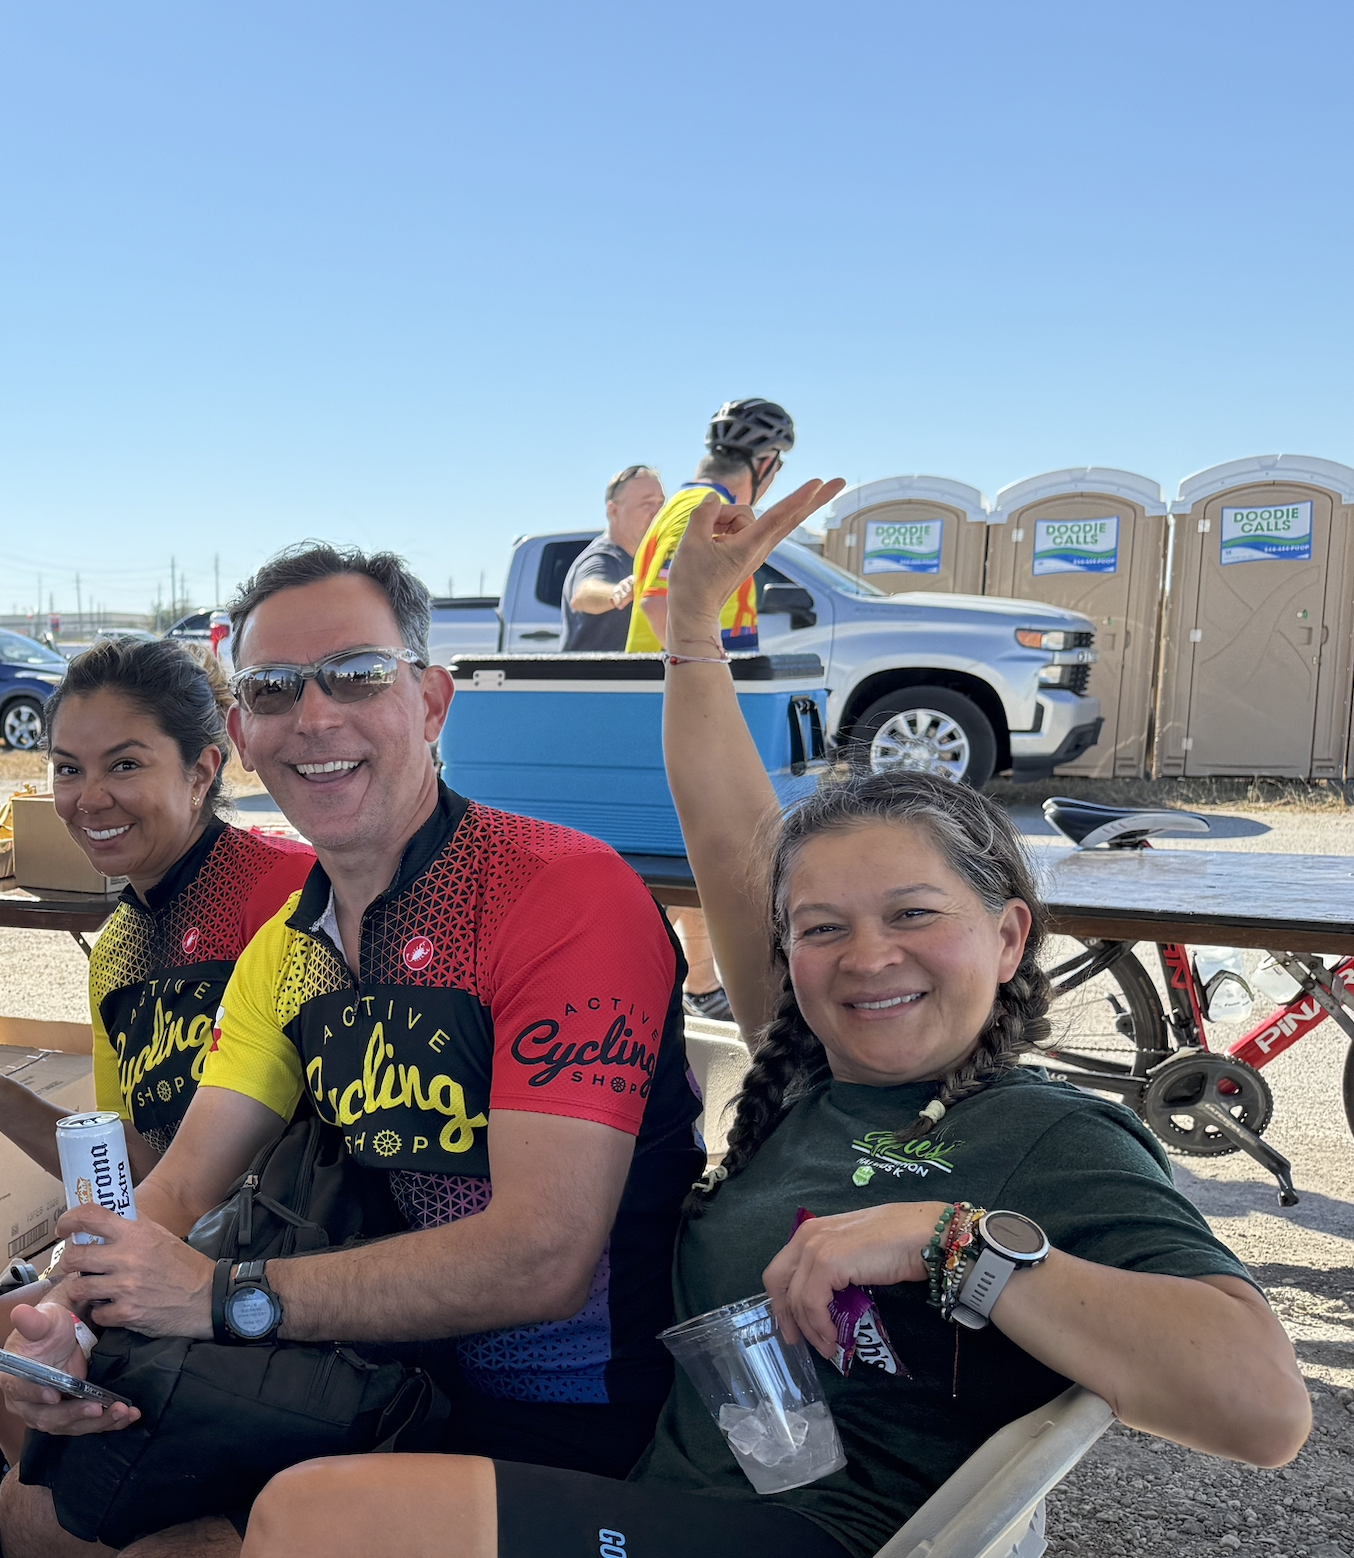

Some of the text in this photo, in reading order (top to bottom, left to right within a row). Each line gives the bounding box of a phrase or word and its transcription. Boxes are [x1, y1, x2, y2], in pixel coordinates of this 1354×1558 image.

[1046, 522, 1106, 535] DOODIE
[1234, 508, 1299, 523] DOODIE
[1241, 519, 1291, 533] CALLS
[876, 525, 931, 537] DOODIE
[881, 536, 924, 547] CALLS
[1052, 534, 1098, 546] CALLS
[323, 996, 451, 1054] ACTIVE
[564, 997, 659, 1042] ACTIVE
[511, 1014, 656, 1099] Cycling
[570, 1070, 637, 1094] SHOP
[344, 1129, 430, 1157] SHOP
[90, 1141, 117, 1212] orona
[116, 1161, 131, 1210] Extra
[598, 1528, 627, 1558] GO
